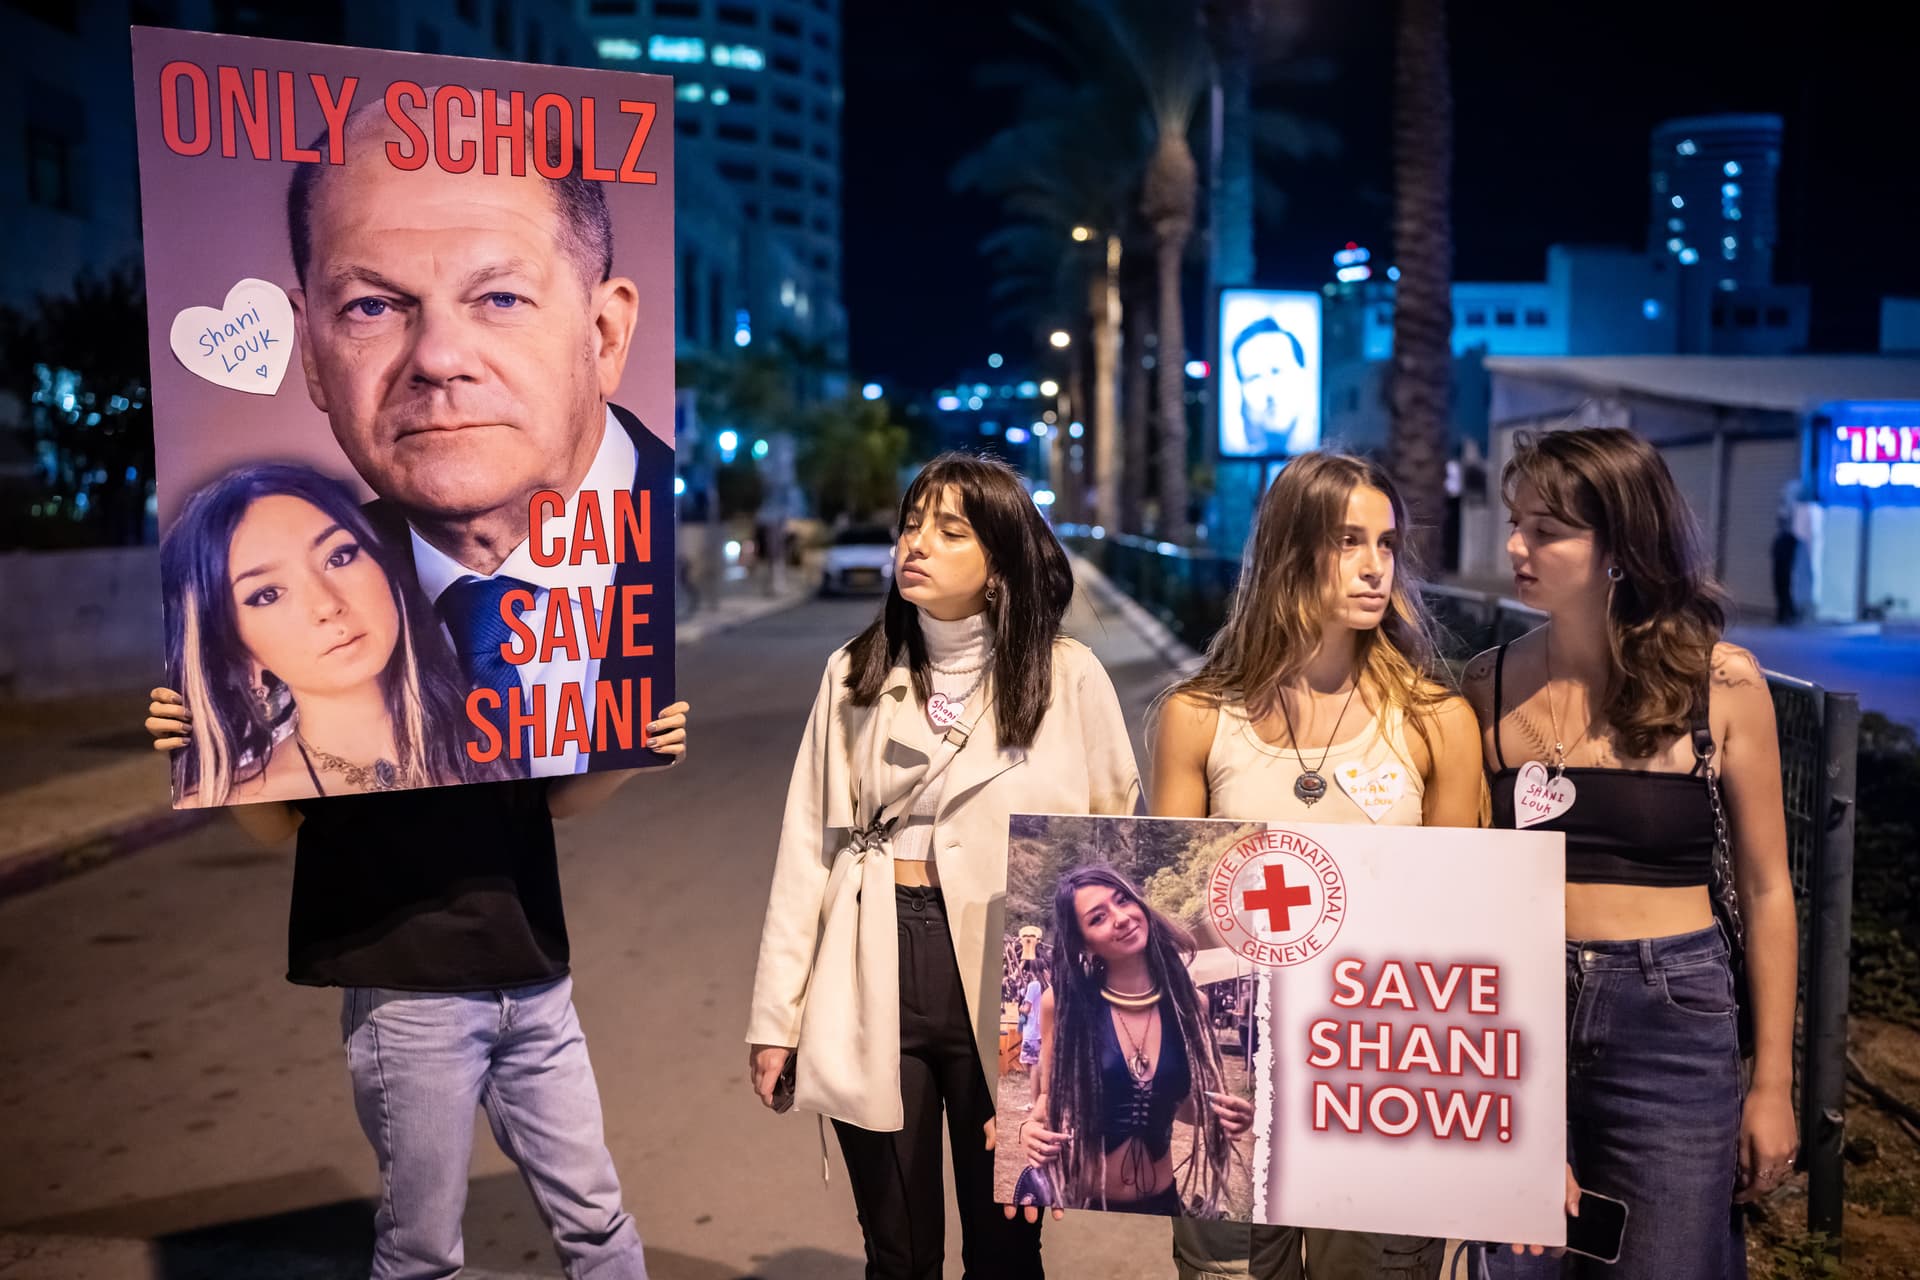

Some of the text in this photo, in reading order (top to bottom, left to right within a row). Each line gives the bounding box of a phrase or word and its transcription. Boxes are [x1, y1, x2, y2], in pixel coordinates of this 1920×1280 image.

[159, 60, 659, 186] ONLY SCHOLZ
[198, 302, 261, 357] Shani
[221, 329, 280, 373] LOUK
[528, 489, 651, 568] CAN
[499, 583, 654, 666] SAVE
[464, 677, 653, 764] SHANI
[1521, 795, 1552, 814] LOUK
[1212, 833, 1343, 932] COMITE INTERNATIONAL
[1242, 934, 1323, 963] GENEVE
[1330, 957, 1500, 1015] SAVE
[1306, 1018, 1521, 1080] SHANI
[1312, 1081, 1513, 1144] NOW!
